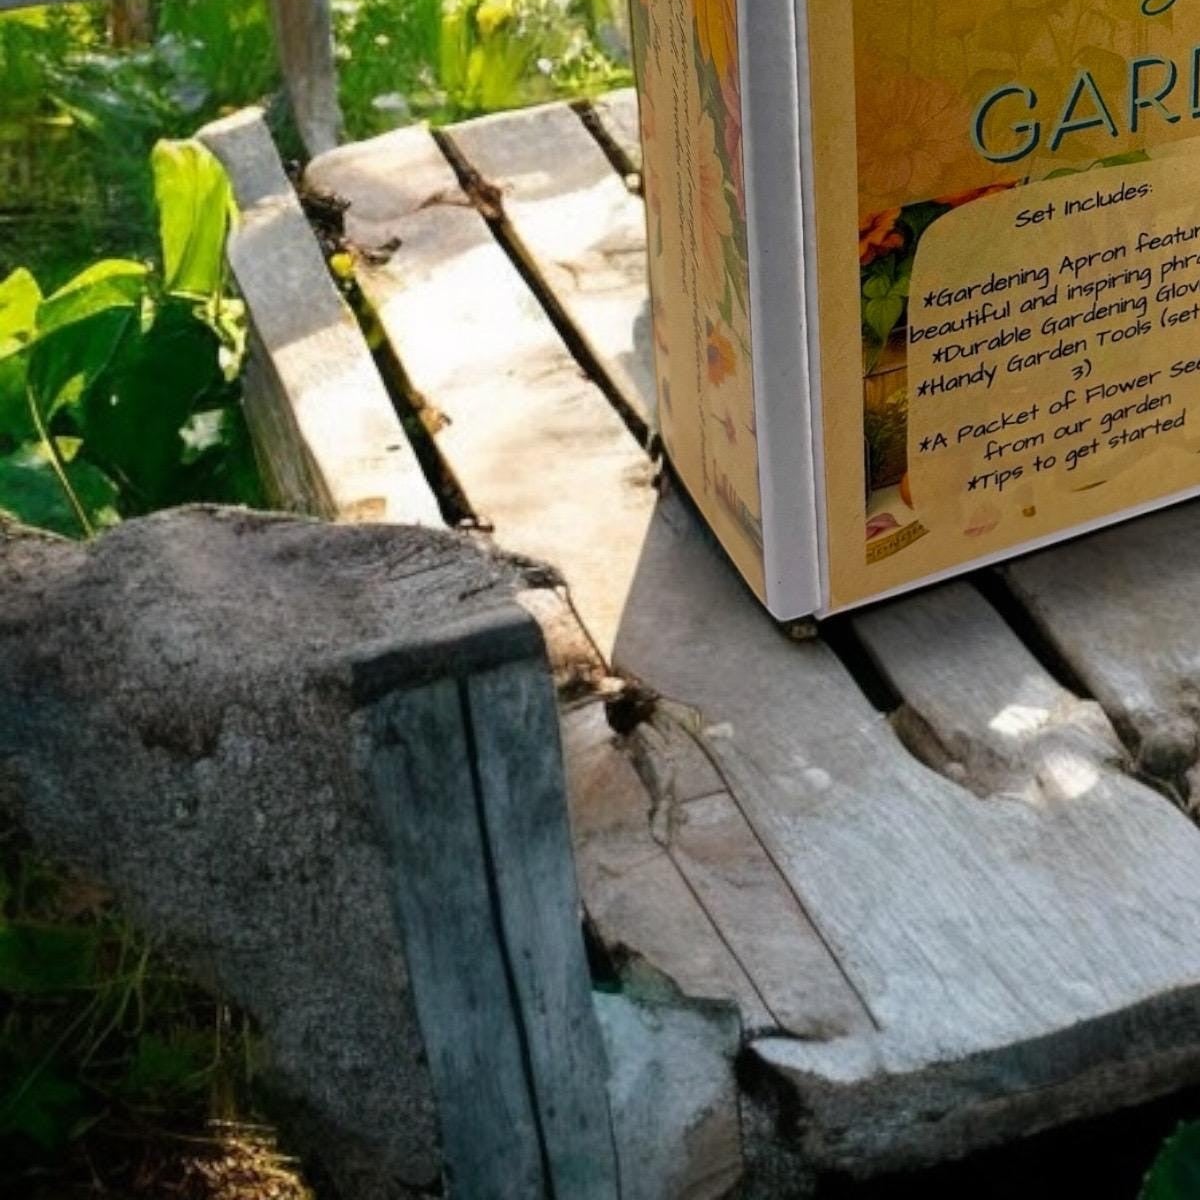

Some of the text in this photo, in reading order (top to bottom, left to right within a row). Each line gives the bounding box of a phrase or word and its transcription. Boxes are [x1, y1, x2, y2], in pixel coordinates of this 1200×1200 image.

[1015, 204, 1056, 229] Set
[1058, 245, 1126, 277] Apron
[909, 304, 1011, 344] beautiful
[1020, 286, 1058, 313] and
[1067, 268, 1152, 303] inspiring
[1007, 337, 1087, 373] Garden
[1096, 316, 1153, 347] Tools
[1160, 304, 1200, 327] (set
[1041, 294, 1148, 337] Gardening
[1072, 359, 1093, 381] 3)
[957, 404, 1040, 441] Packet
[1049, 390, 1077, 415] of
[1085, 370, 1161, 404] Flower
[983, 391, 1172, 461] from our garden
[1032, 453, 1056, 473] to
[1065, 441, 1098, 471] get
[1108, 408, 1186, 449] started
